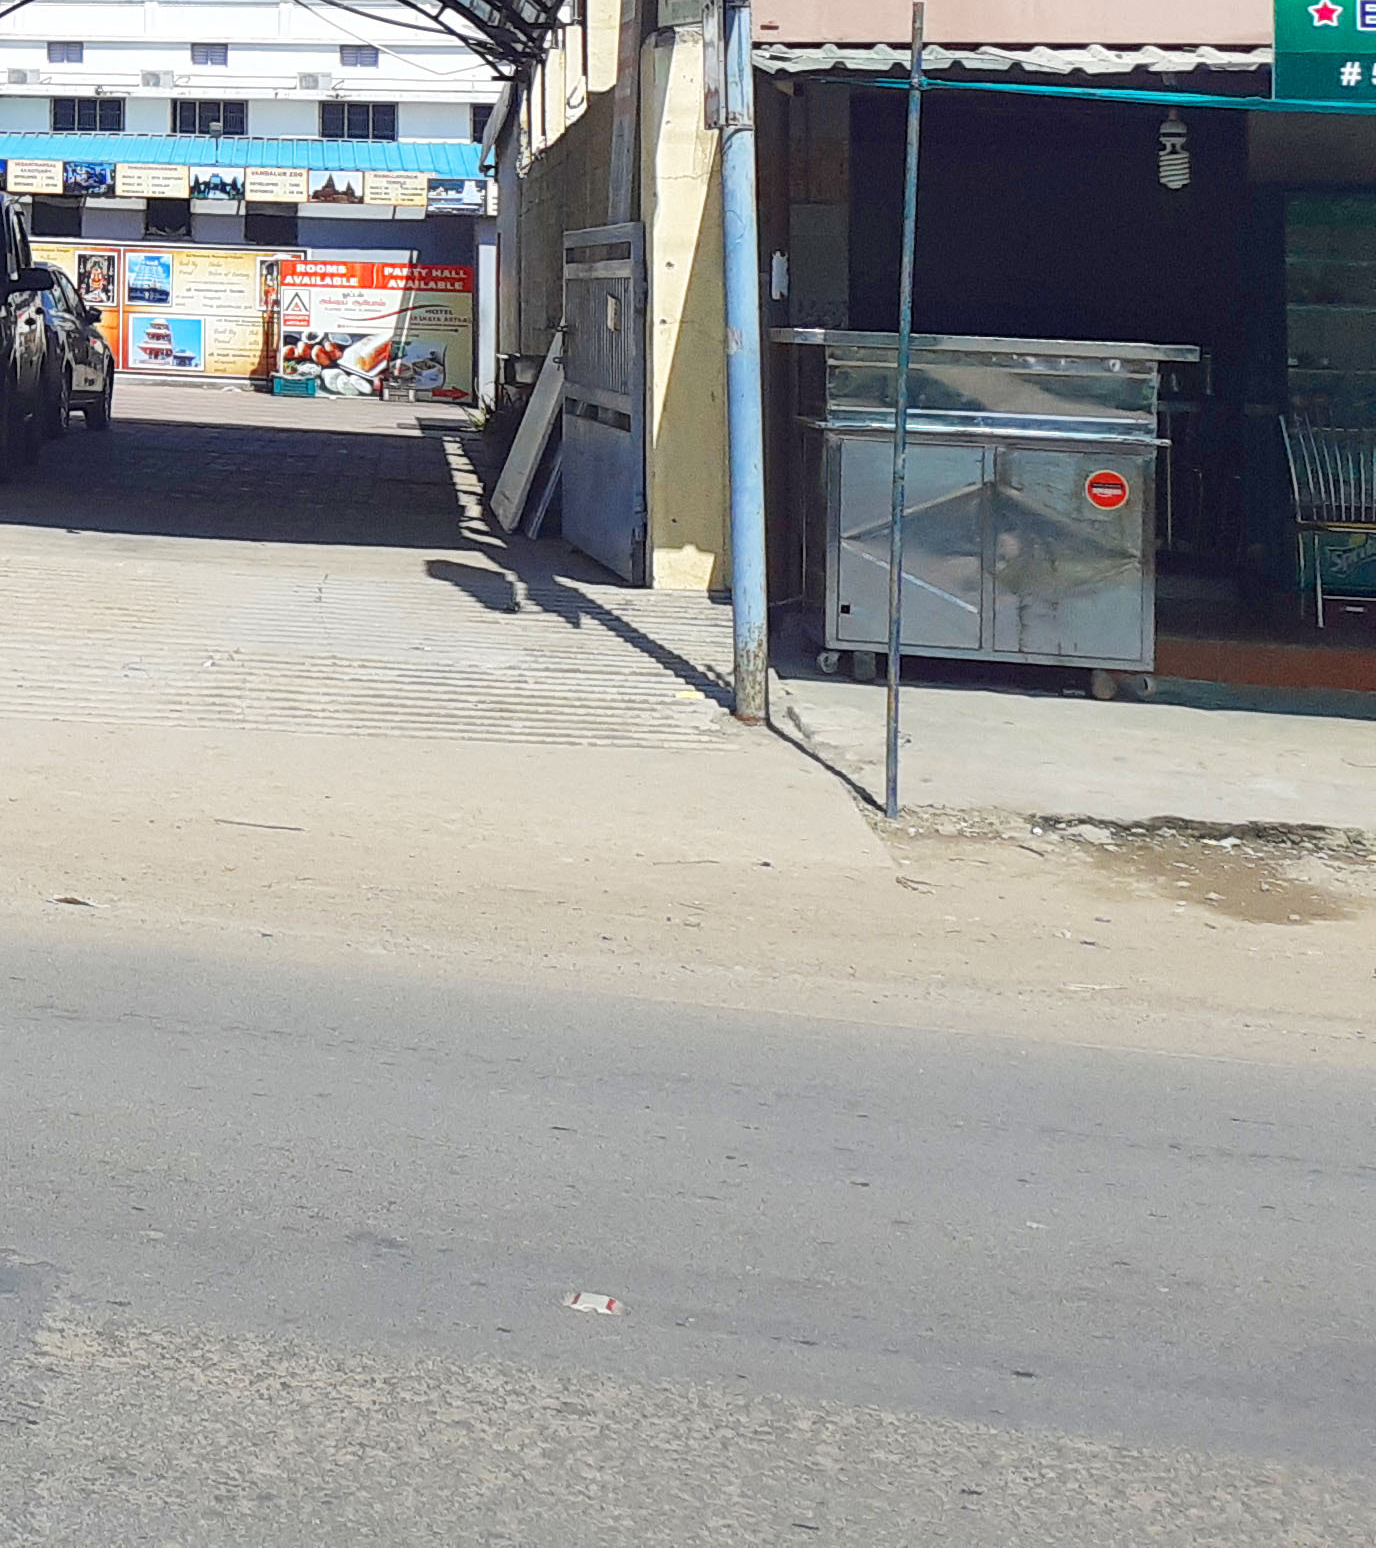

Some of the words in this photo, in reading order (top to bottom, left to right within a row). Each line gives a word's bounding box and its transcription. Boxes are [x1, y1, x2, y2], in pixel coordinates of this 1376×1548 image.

[295, 263, 348, 275] ROOMS
[383, 266, 429, 277] PARTY
[431, 268, 468, 279] HALL
[283, 275, 359, 286] AVAILABLE
[386, 279, 464, 291] AVAILABLE
